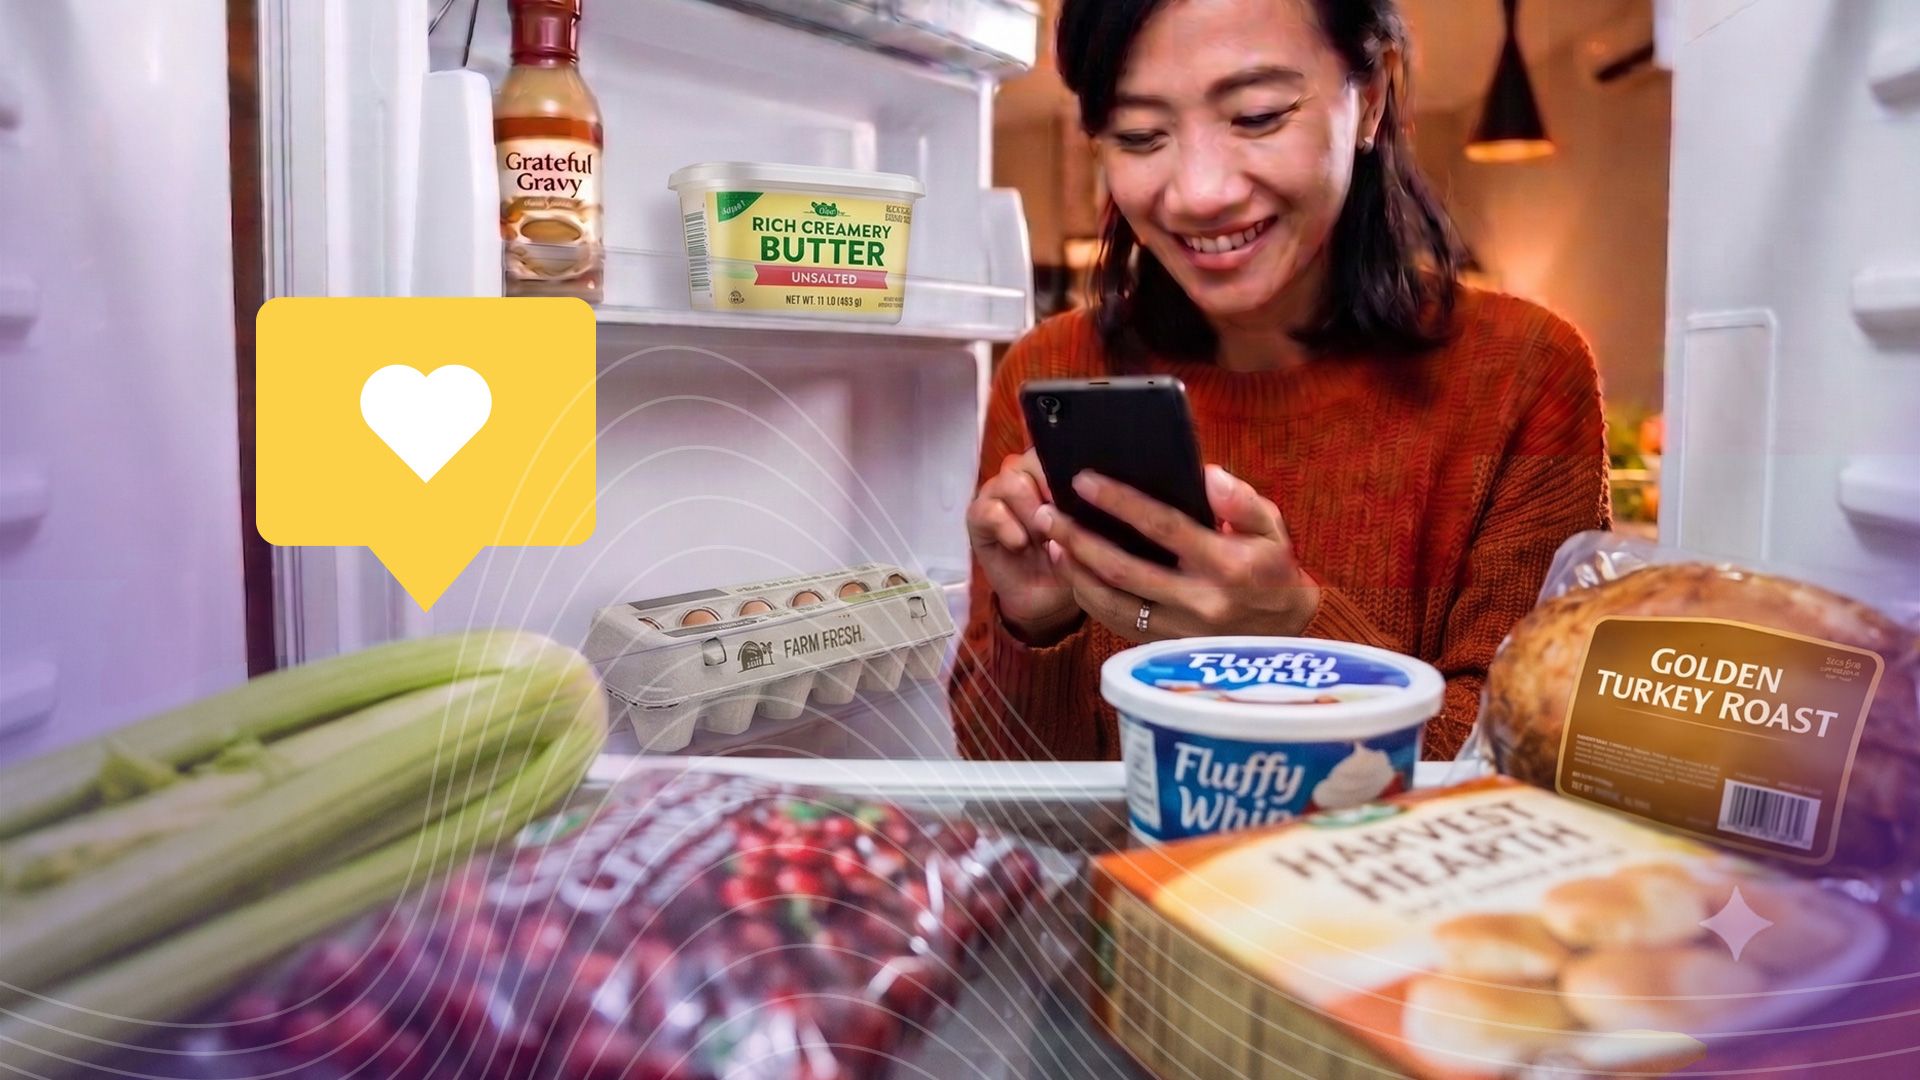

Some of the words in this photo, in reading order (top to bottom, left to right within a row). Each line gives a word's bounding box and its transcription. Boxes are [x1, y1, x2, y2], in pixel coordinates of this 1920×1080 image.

[505, 151, 593, 174] Grateful
[517, 173, 583, 198] Gravy
[752, 217, 796, 233] RICH
[801, 220, 892, 239] CREAMERY
[760, 235, 885, 266] BUTTER
[791, 271, 857, 284] UNSALTED
[785, 294, 801, 304] NET
[802, 295, 816, 305] WT.
[783, 632, 820, 658] FARM
[1188, 652, 1338, 673] Fluffy
[1650, 647, 1784, 694] GOLDEN
[1200, 666, 1341, 688] Whip
[1597, 669, 1714, 715] TURKEY
[1718, 691, 1839, 738] ROAST
[1174, 741, 1305, 805] Fluffy
[1273, 800, 1536, 880] HARVEST
[1337, 821, 1593, 902] HEARTH
